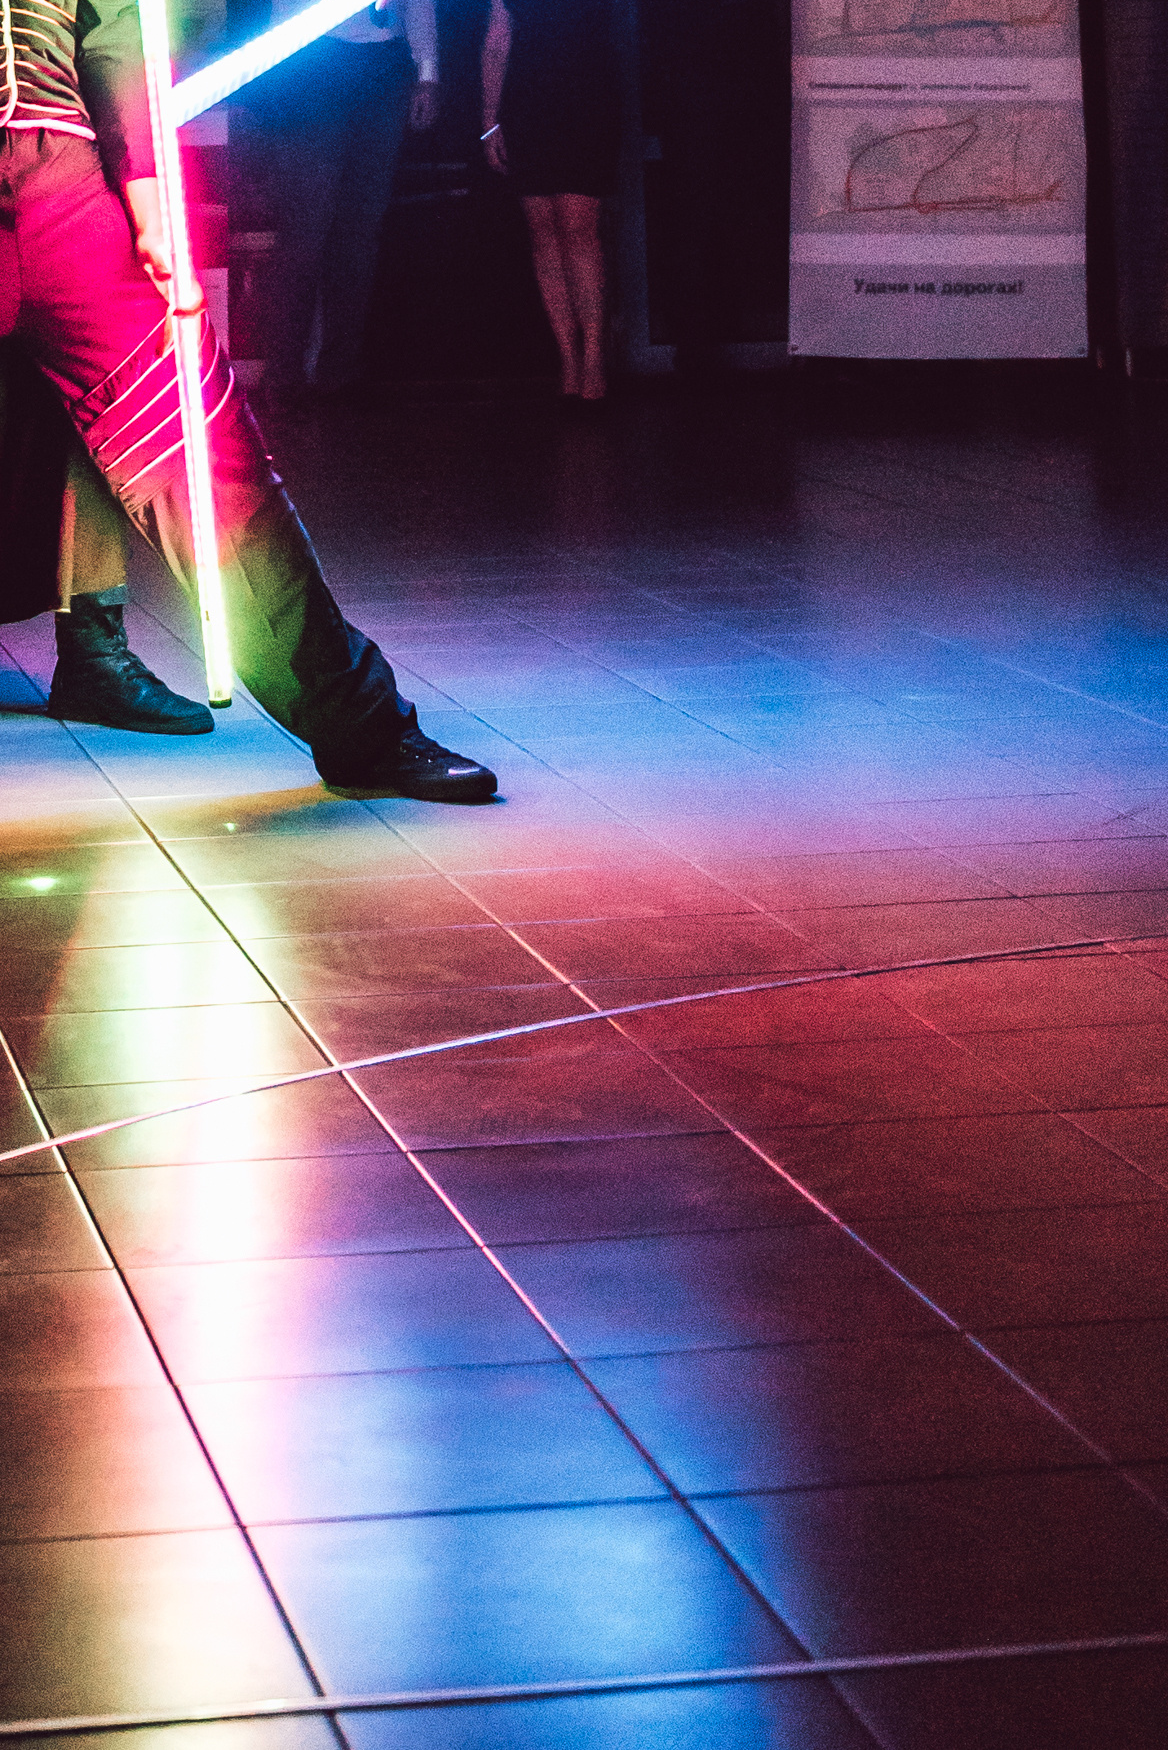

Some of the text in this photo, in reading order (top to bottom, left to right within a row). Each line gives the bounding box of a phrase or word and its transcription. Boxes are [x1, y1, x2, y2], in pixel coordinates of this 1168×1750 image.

[853, 278, 1025, 296] Удачи на дорогах!
